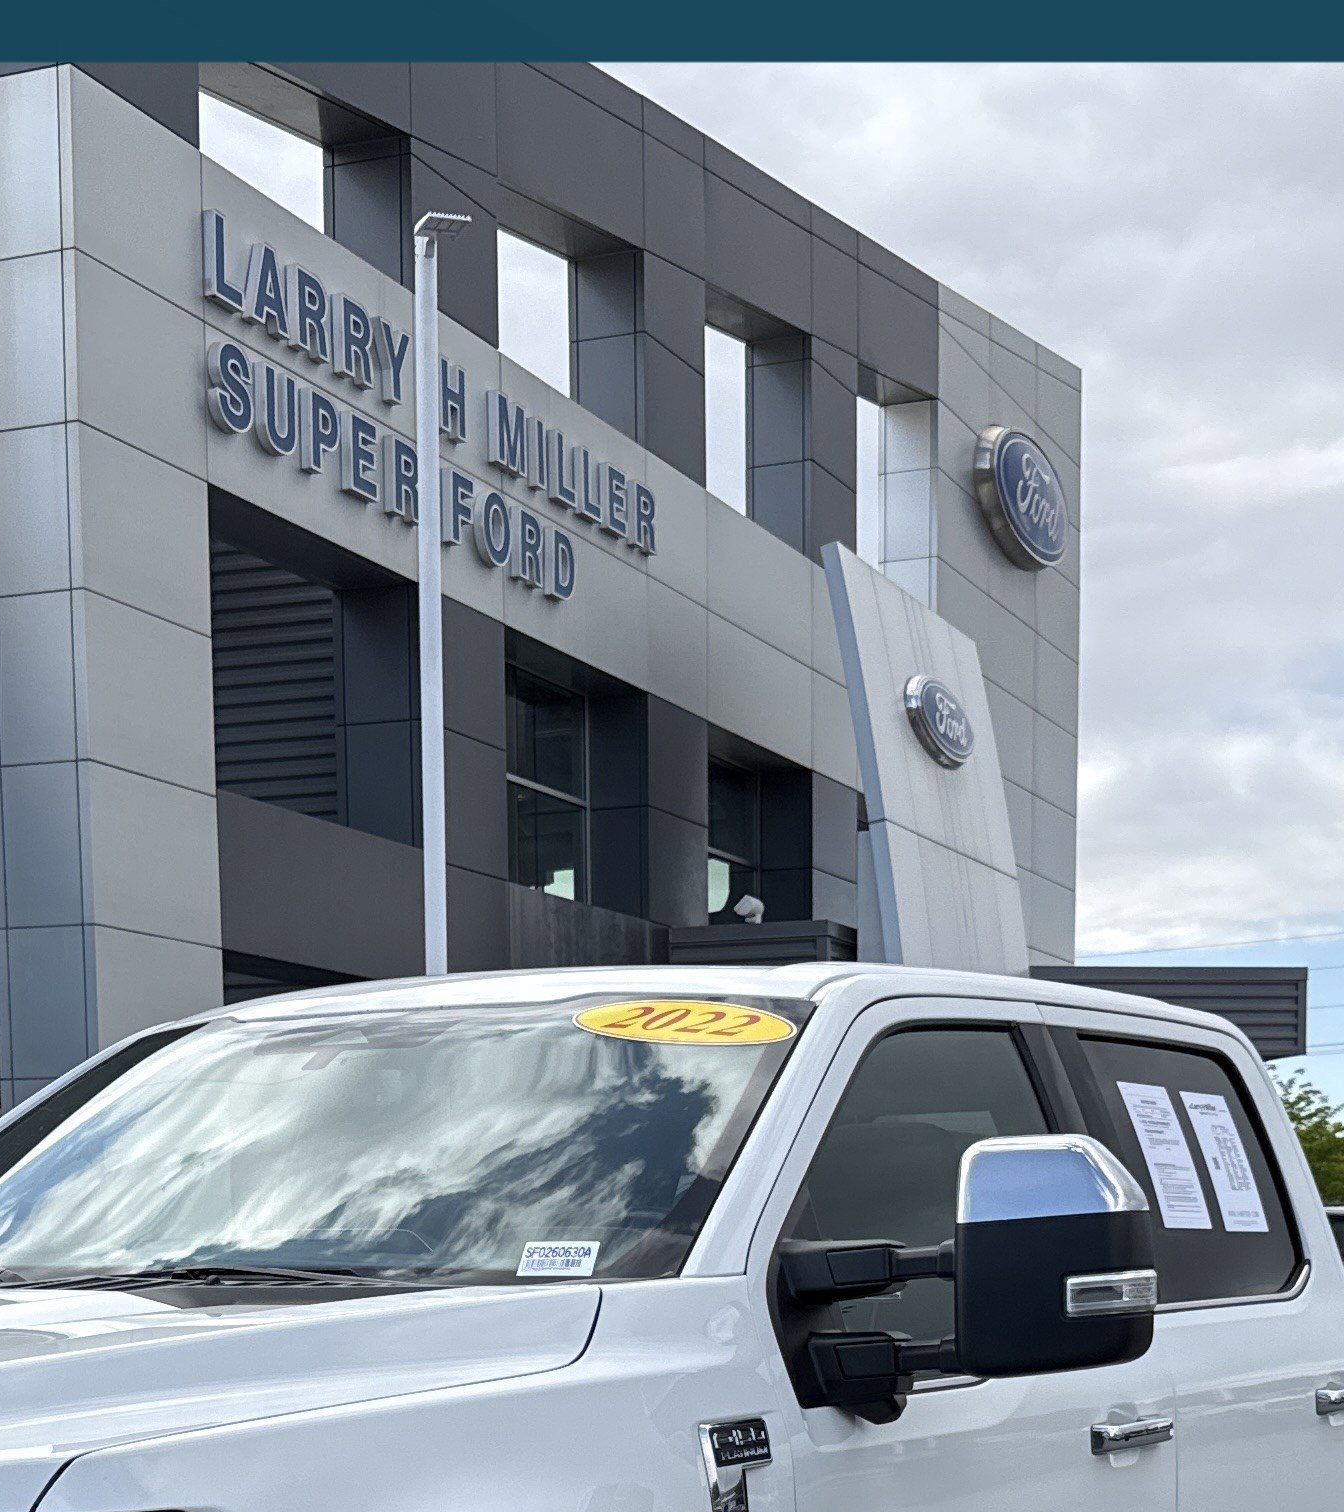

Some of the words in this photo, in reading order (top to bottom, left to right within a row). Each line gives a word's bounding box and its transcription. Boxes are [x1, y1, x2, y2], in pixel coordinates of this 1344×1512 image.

[203, 208, 411, 406] LARRY
[439, 353, 468, 444] H
[487, 389, 657, 557] MILLER
[207, 341, 419, 527] SUPER
[441, 466, 577, 602] FORD
[1016, 452, 1060, 542] Ford
[935, 692, 968, 747] Ford
[599, 1005, 762, 1037] 2022
